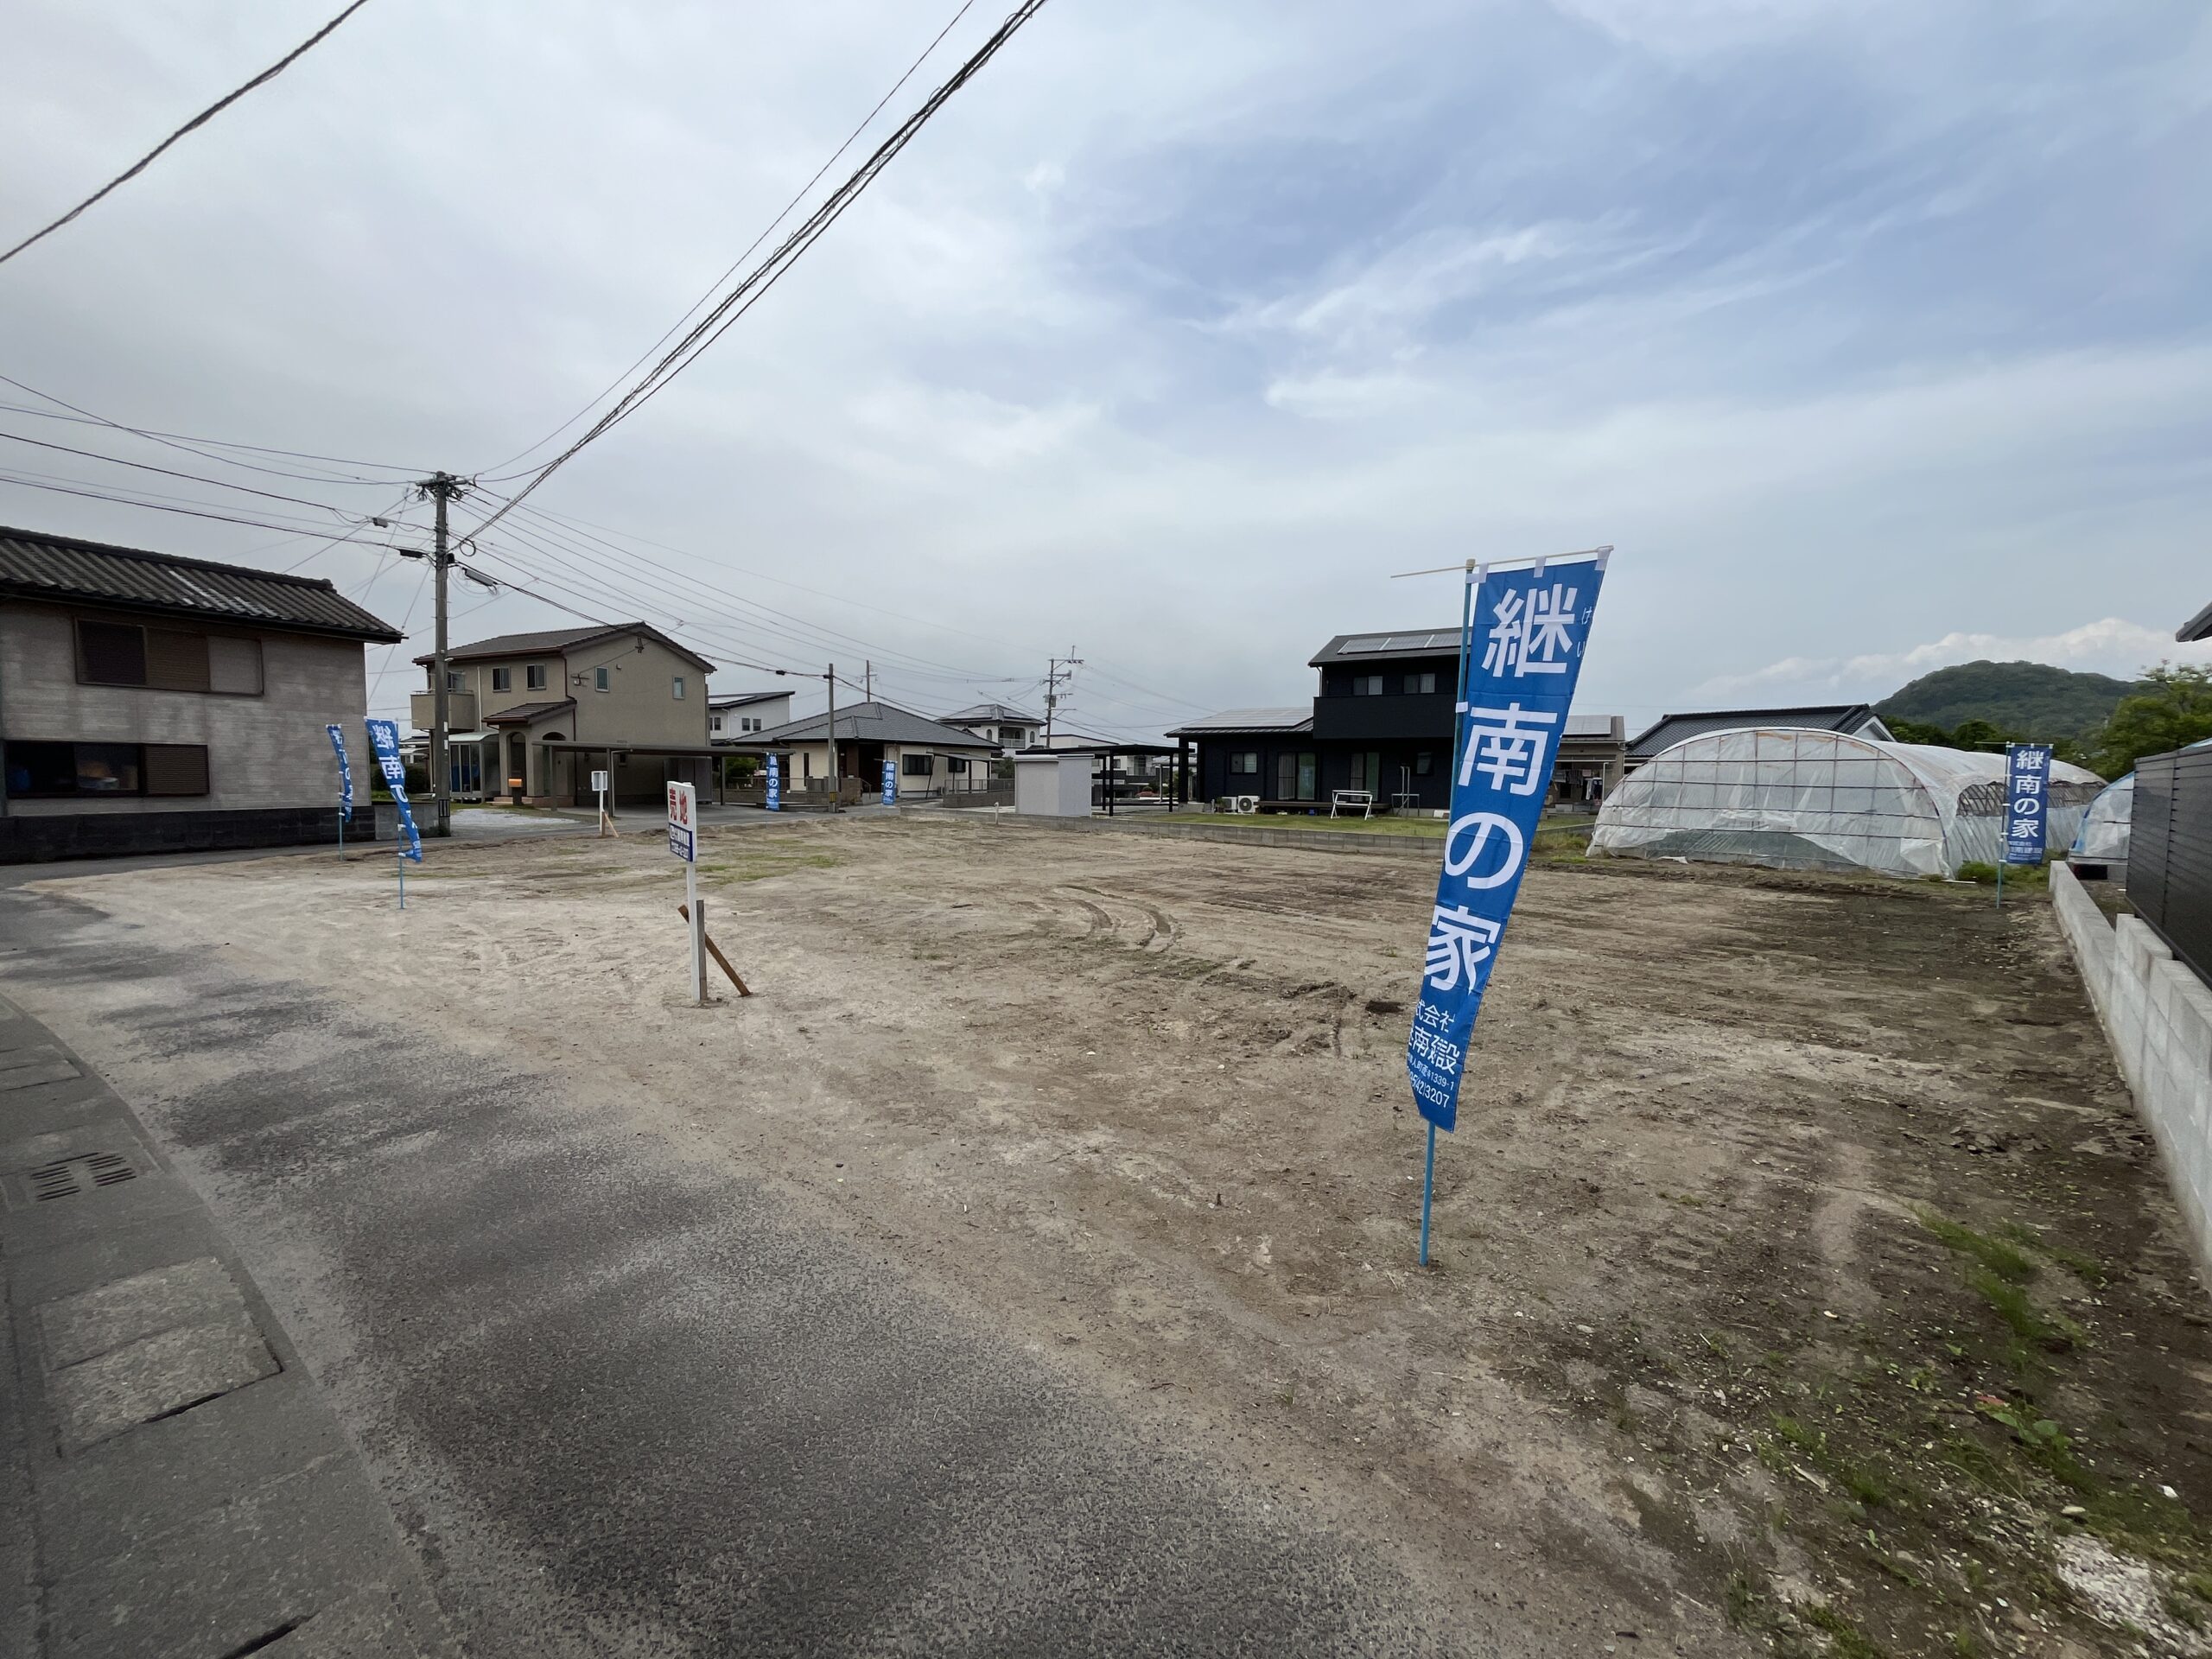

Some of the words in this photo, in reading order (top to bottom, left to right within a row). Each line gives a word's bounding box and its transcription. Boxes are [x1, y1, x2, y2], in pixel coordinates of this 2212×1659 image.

[669, 787, 688, 825] 売地
[1424, 582, 1578, 995] 継南の家
[2012, 750, 2044, 838] 継南の家
[1408, 1025, 1460, 1075] 南建設
